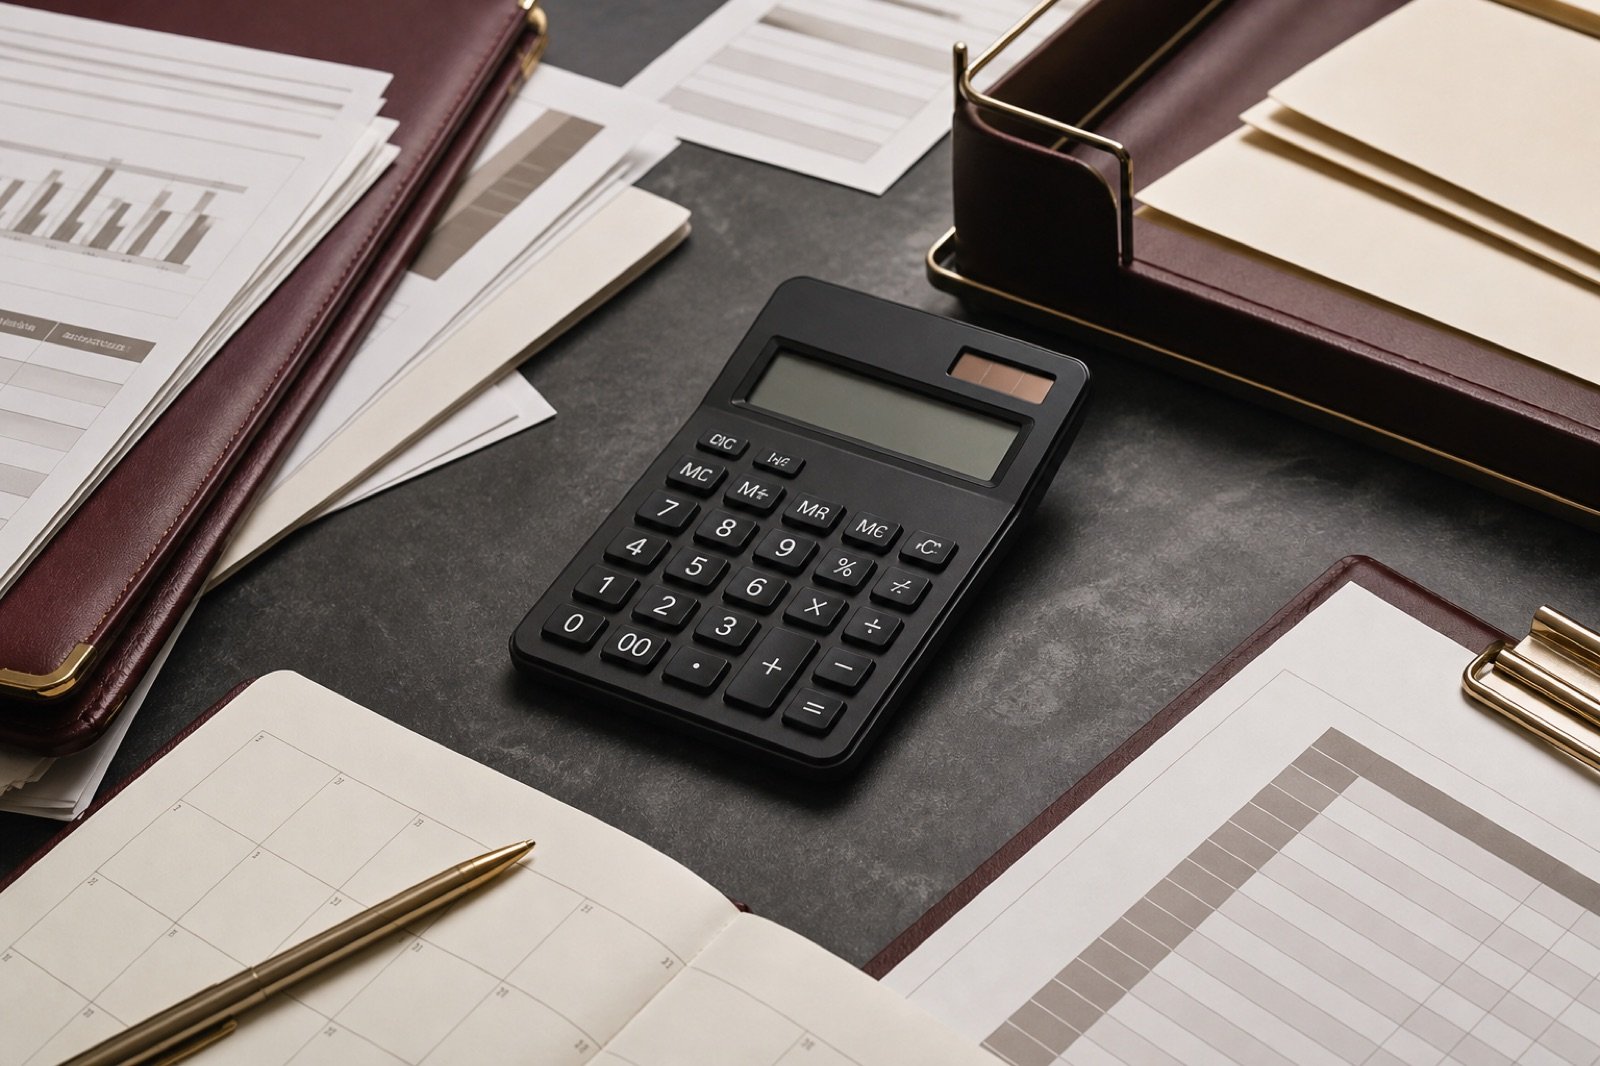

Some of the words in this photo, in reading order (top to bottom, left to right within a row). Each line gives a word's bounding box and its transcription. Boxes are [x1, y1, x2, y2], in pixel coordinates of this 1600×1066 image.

[680, 461, 713, 482] MC
[656, 498, 680, 517] 7
[796, 499, 830, 521] MR
[716, 518, 737, 537] 8
[626, 538, 648, 556] 4
[775, 538, 796, 557] 9
[685, 556, 708, 576] 5
[833, 557, 857, 577] %
[598, 576, 615, 594] 1
[746, 577, 768, 597] 6
[653, 595, 677, 616] 2
[563, 613, 584, 633] 0
[714, 616, 737, 636] 3
[617, 632, 652, 657] 00
